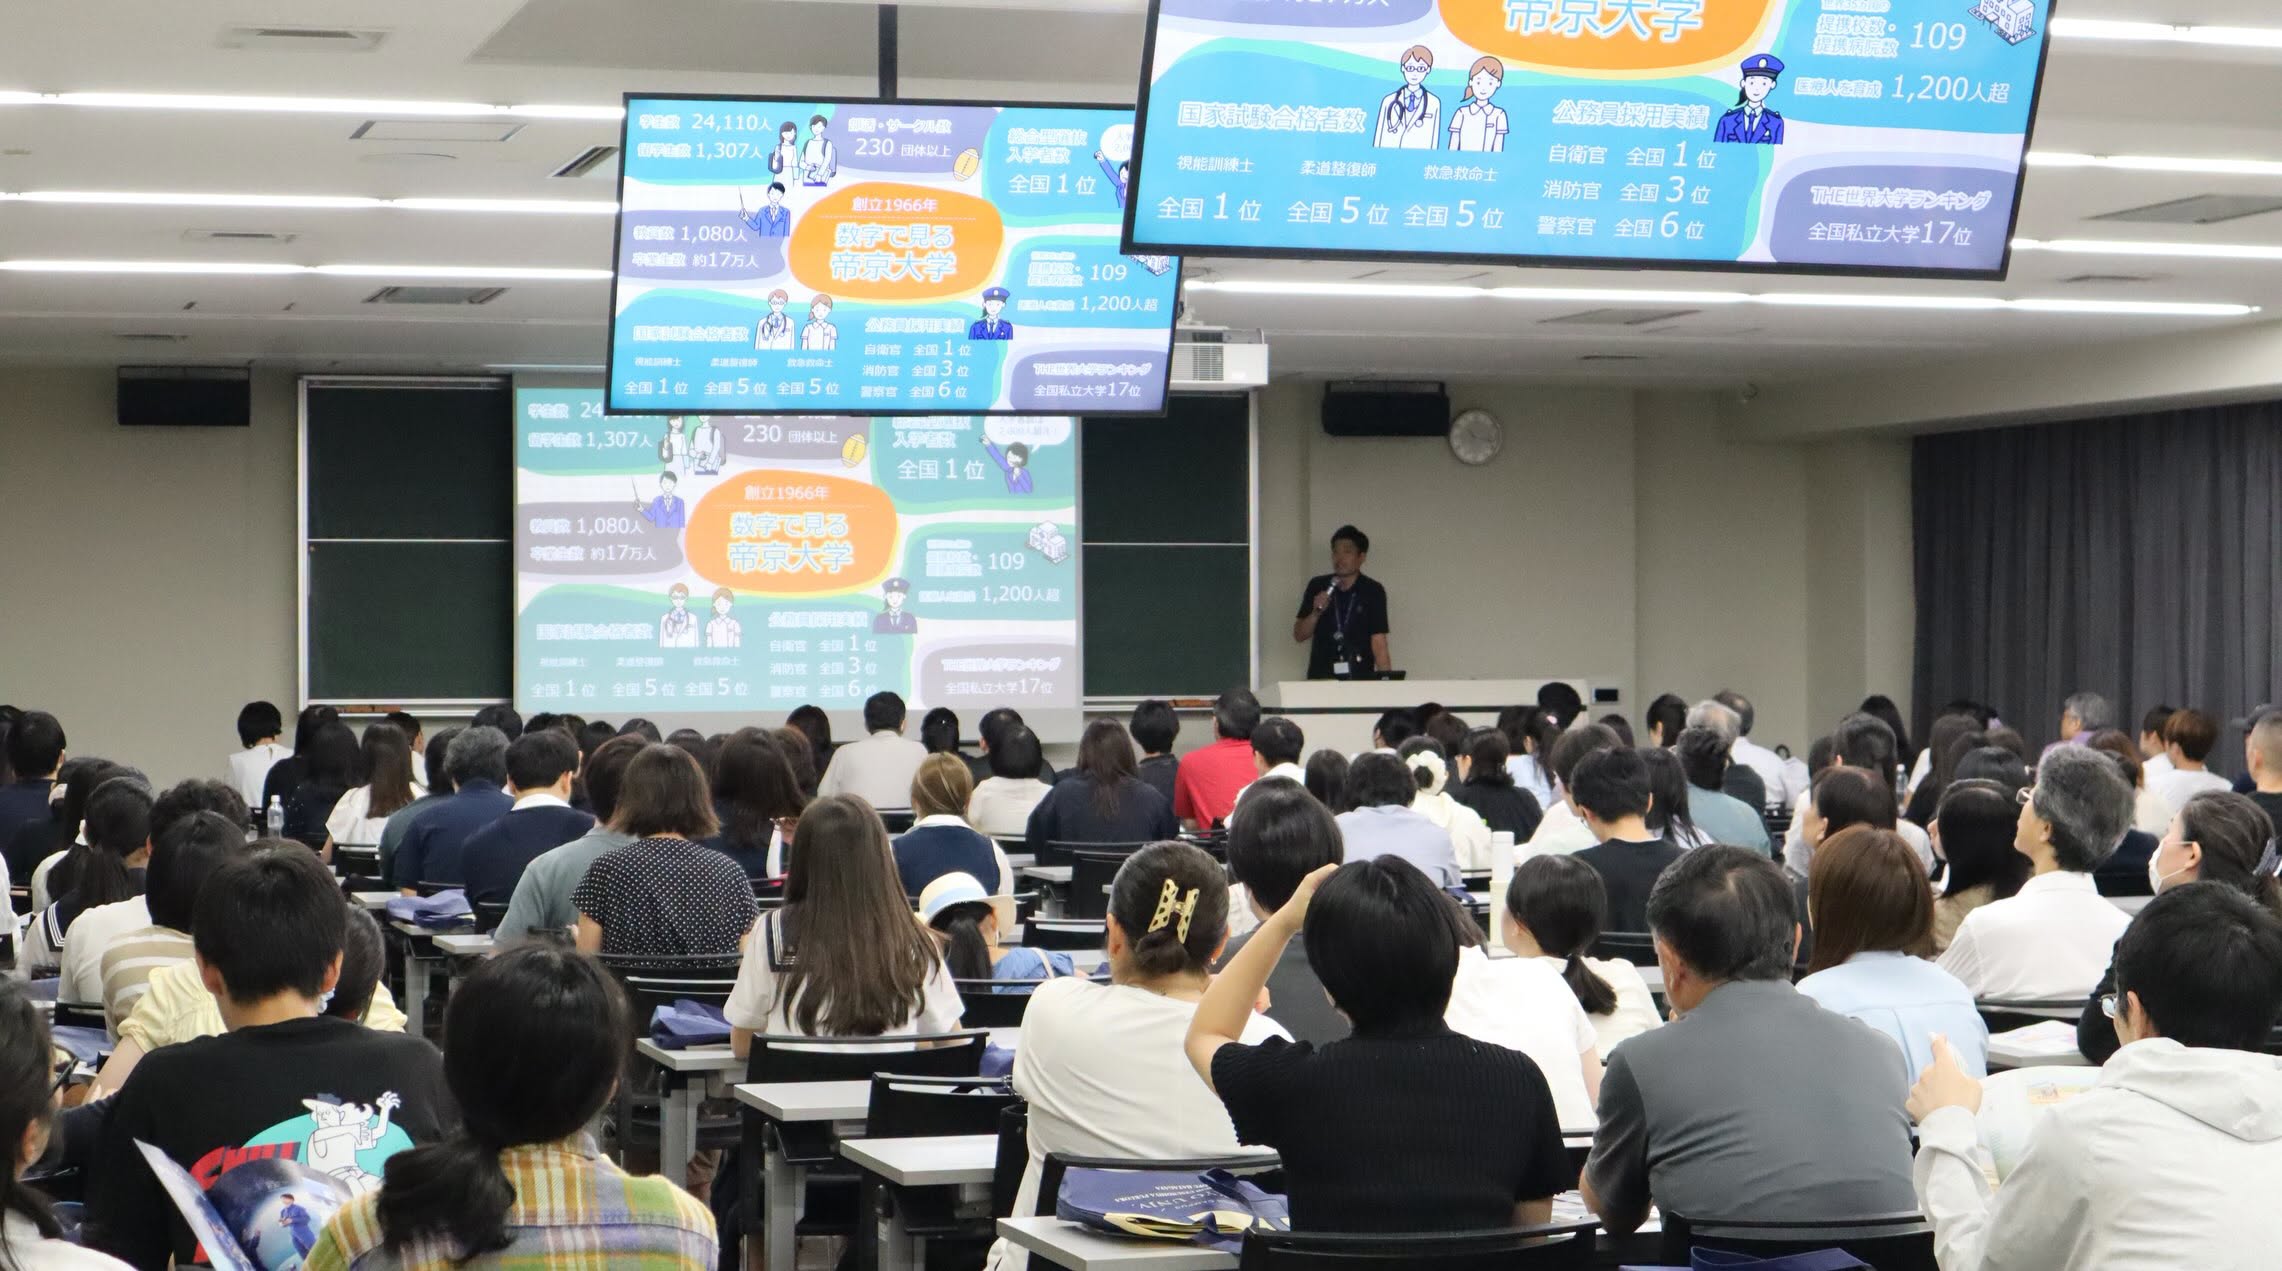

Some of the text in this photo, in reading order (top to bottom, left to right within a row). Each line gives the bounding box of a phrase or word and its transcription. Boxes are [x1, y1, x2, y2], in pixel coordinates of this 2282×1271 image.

[1909, 21, 1967, 51] 109
[1891, 74, 2010, 104] 1,200人超
[691, 113, 772, 132] 24,110人
[1177, 101, 1367, 133] 国家試験合格者数
[1552, 99, 1710, 130] 公務員採用実績
[696, 142, 763, 160] 1,307人
[855, 138, 952, 157] 230 団体以上
[1549, 143, 1608, 165] 自衛官
[1176, 155, 1255, 174] 視能訓練士
[1300, 160, 1377, 178] 柔道整復師
[1423, 164, 1499, 182] 救急救命士
[1542, 179, 1602, 201] 消防官
[1810, 185, 1992, 212] THE世界大学ランキング
[852, 197, 938, 212] 創立1966年
[680, 225, 748, 244] 1,080人
[835, 222, 955, 248] 数字で見る
[1537, 215, 1597, 236] 警察官
[1808, 220, 1973, 246] 全国私立大学17位
[692, 252, 759, 268] 約17万人
[829, 248, 958, 282] 帝京大学
[1090, 264, 1127, 281] 109
[1081, 296, 1158, 313] 1,200人超
[1034, 382, 1141, 397] 全国私立大学17位
[586, 431, 653, 450] 1,307人
[743, 424, 782, 442] 230
[577, 517, 644, 536] 1,080人
[730, 511, 849, 538] 数字で見る
[727, 540, 855, 573] 帝京大学
[988, 552, 1024, 570] 109
